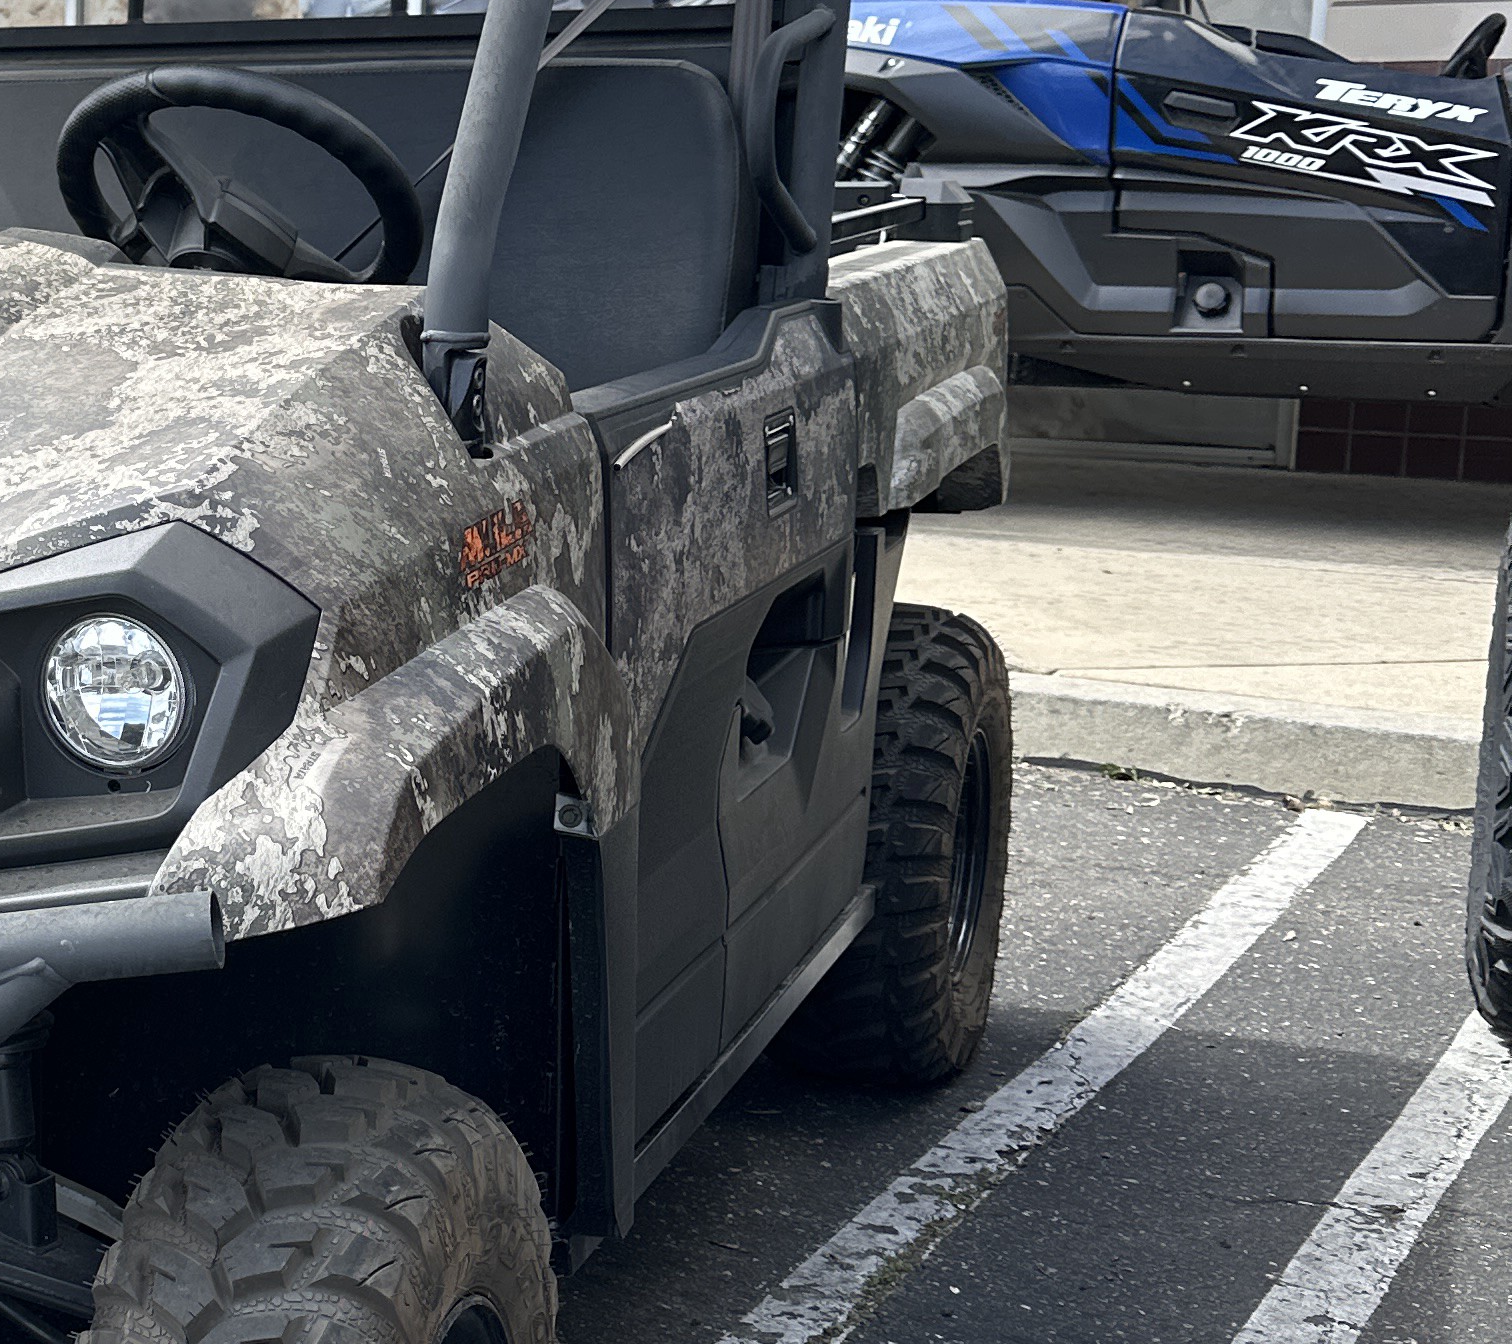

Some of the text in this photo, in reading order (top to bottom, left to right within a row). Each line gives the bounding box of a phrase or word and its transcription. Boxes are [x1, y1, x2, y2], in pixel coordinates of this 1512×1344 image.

[1316, 78, 1488, 123] TERYX
[1229, 100, 1499, 190] KRX
[1241, 145, 1326, 171] 1000
